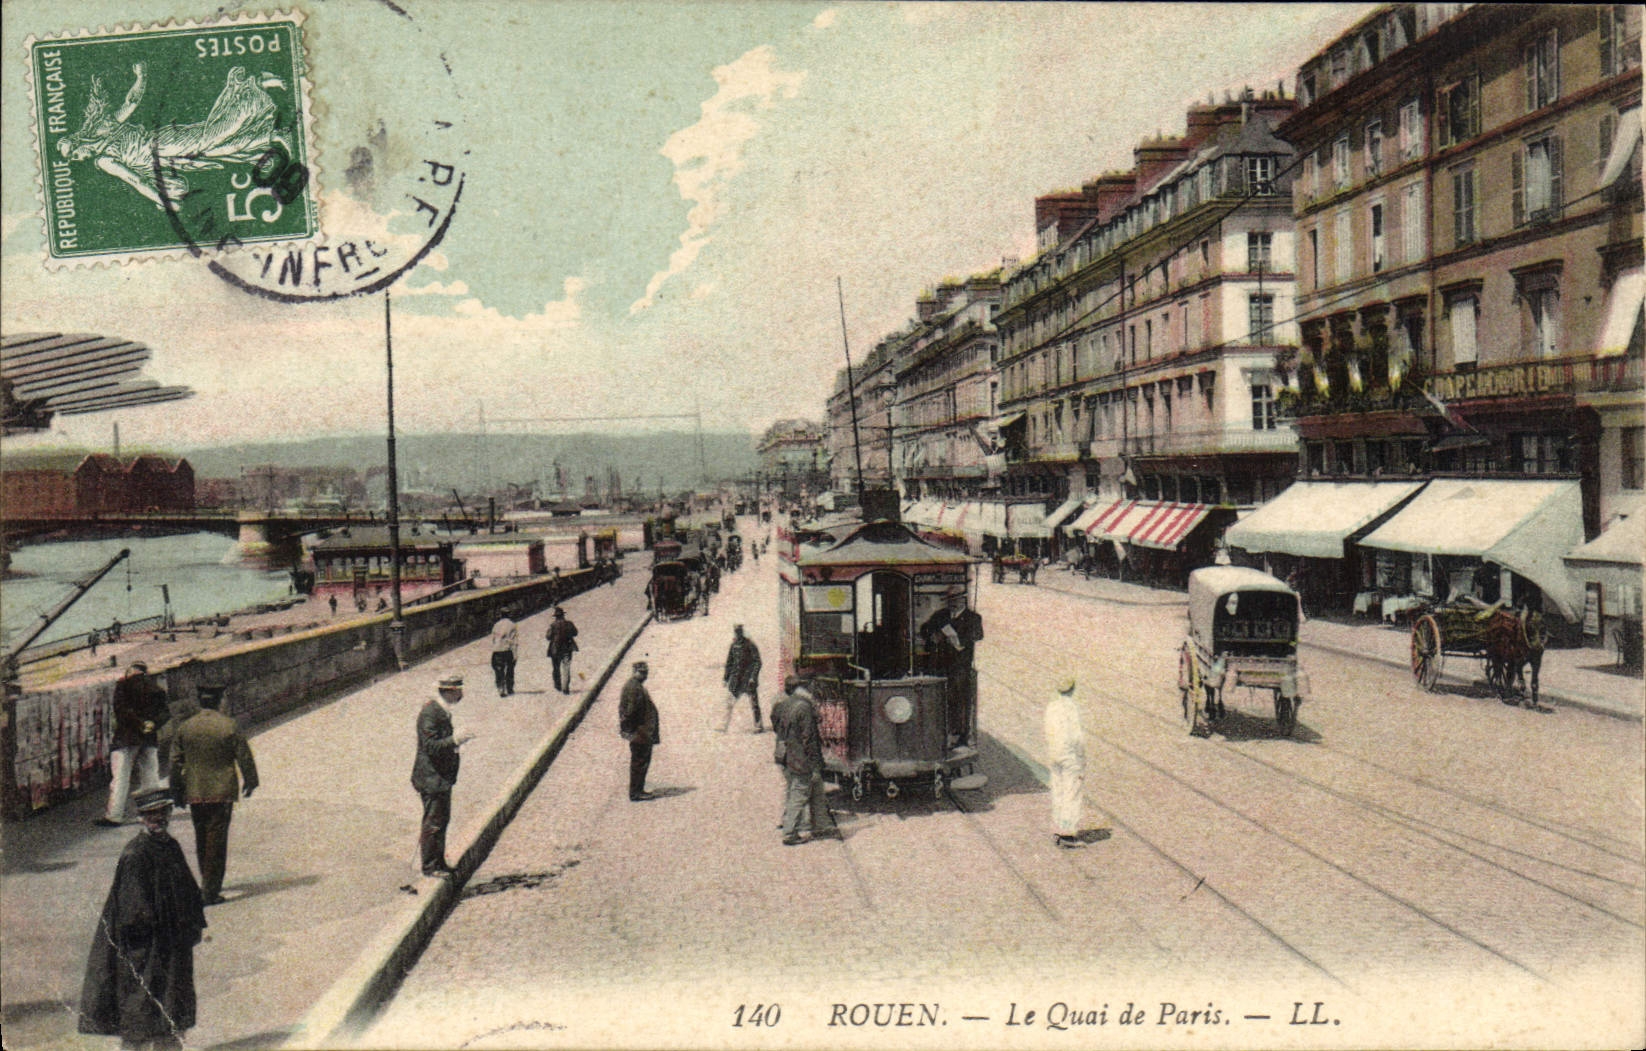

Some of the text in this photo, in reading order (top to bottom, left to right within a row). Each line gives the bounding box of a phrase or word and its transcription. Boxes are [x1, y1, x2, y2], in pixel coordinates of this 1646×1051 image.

[195, 33, 281, 58] POSTES
[43, 49, 78, 250] REPUBLIQUE FRANÇAISE
